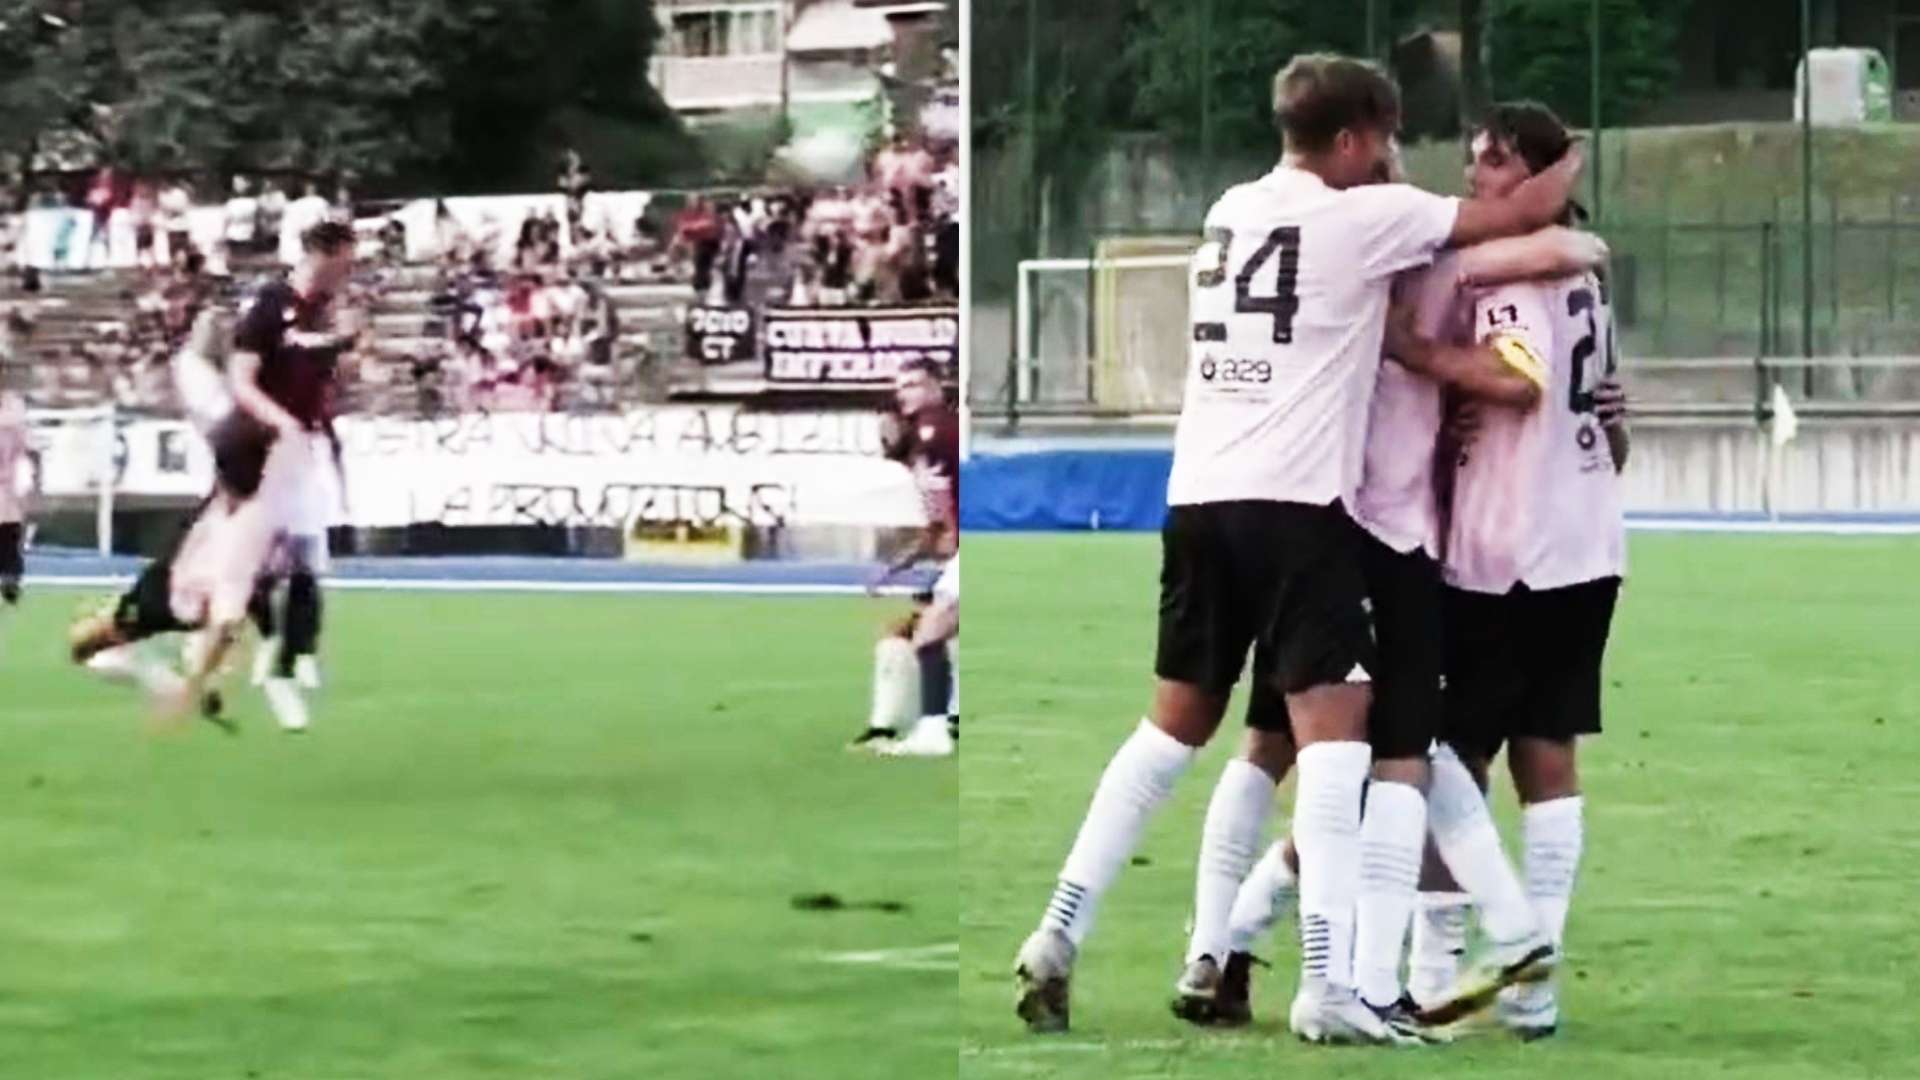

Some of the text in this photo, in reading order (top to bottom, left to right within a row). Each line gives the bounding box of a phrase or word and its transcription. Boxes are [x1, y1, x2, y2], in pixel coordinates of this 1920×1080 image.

[1194, 226, 1301, 344] 24
[766, 319, 863, 349] CURVA
[771, 350, 950, 379] INFERIO
